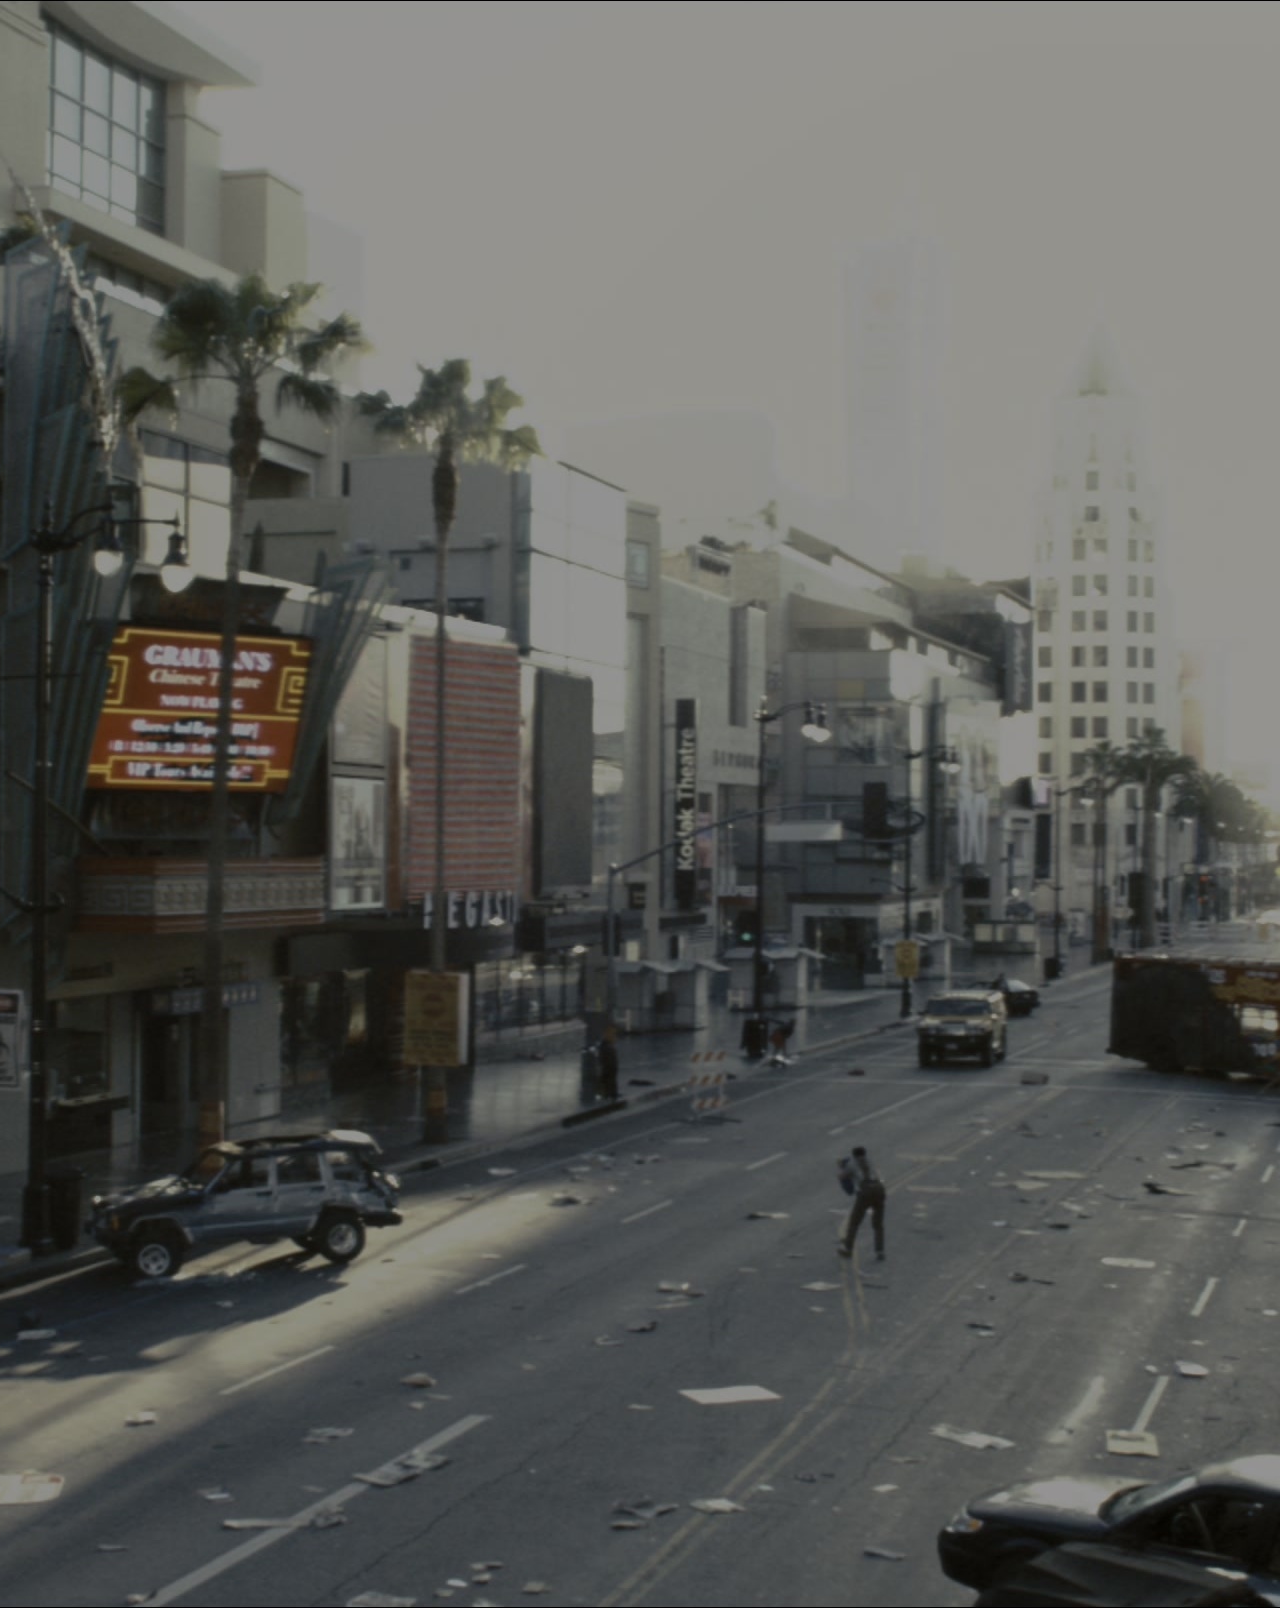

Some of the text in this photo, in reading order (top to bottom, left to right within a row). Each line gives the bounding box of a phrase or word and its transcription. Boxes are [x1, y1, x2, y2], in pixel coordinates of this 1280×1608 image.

[149, 668, 263, 690] Chinese Tatre
[676, 729, 696, 870] Kodak Theatre
